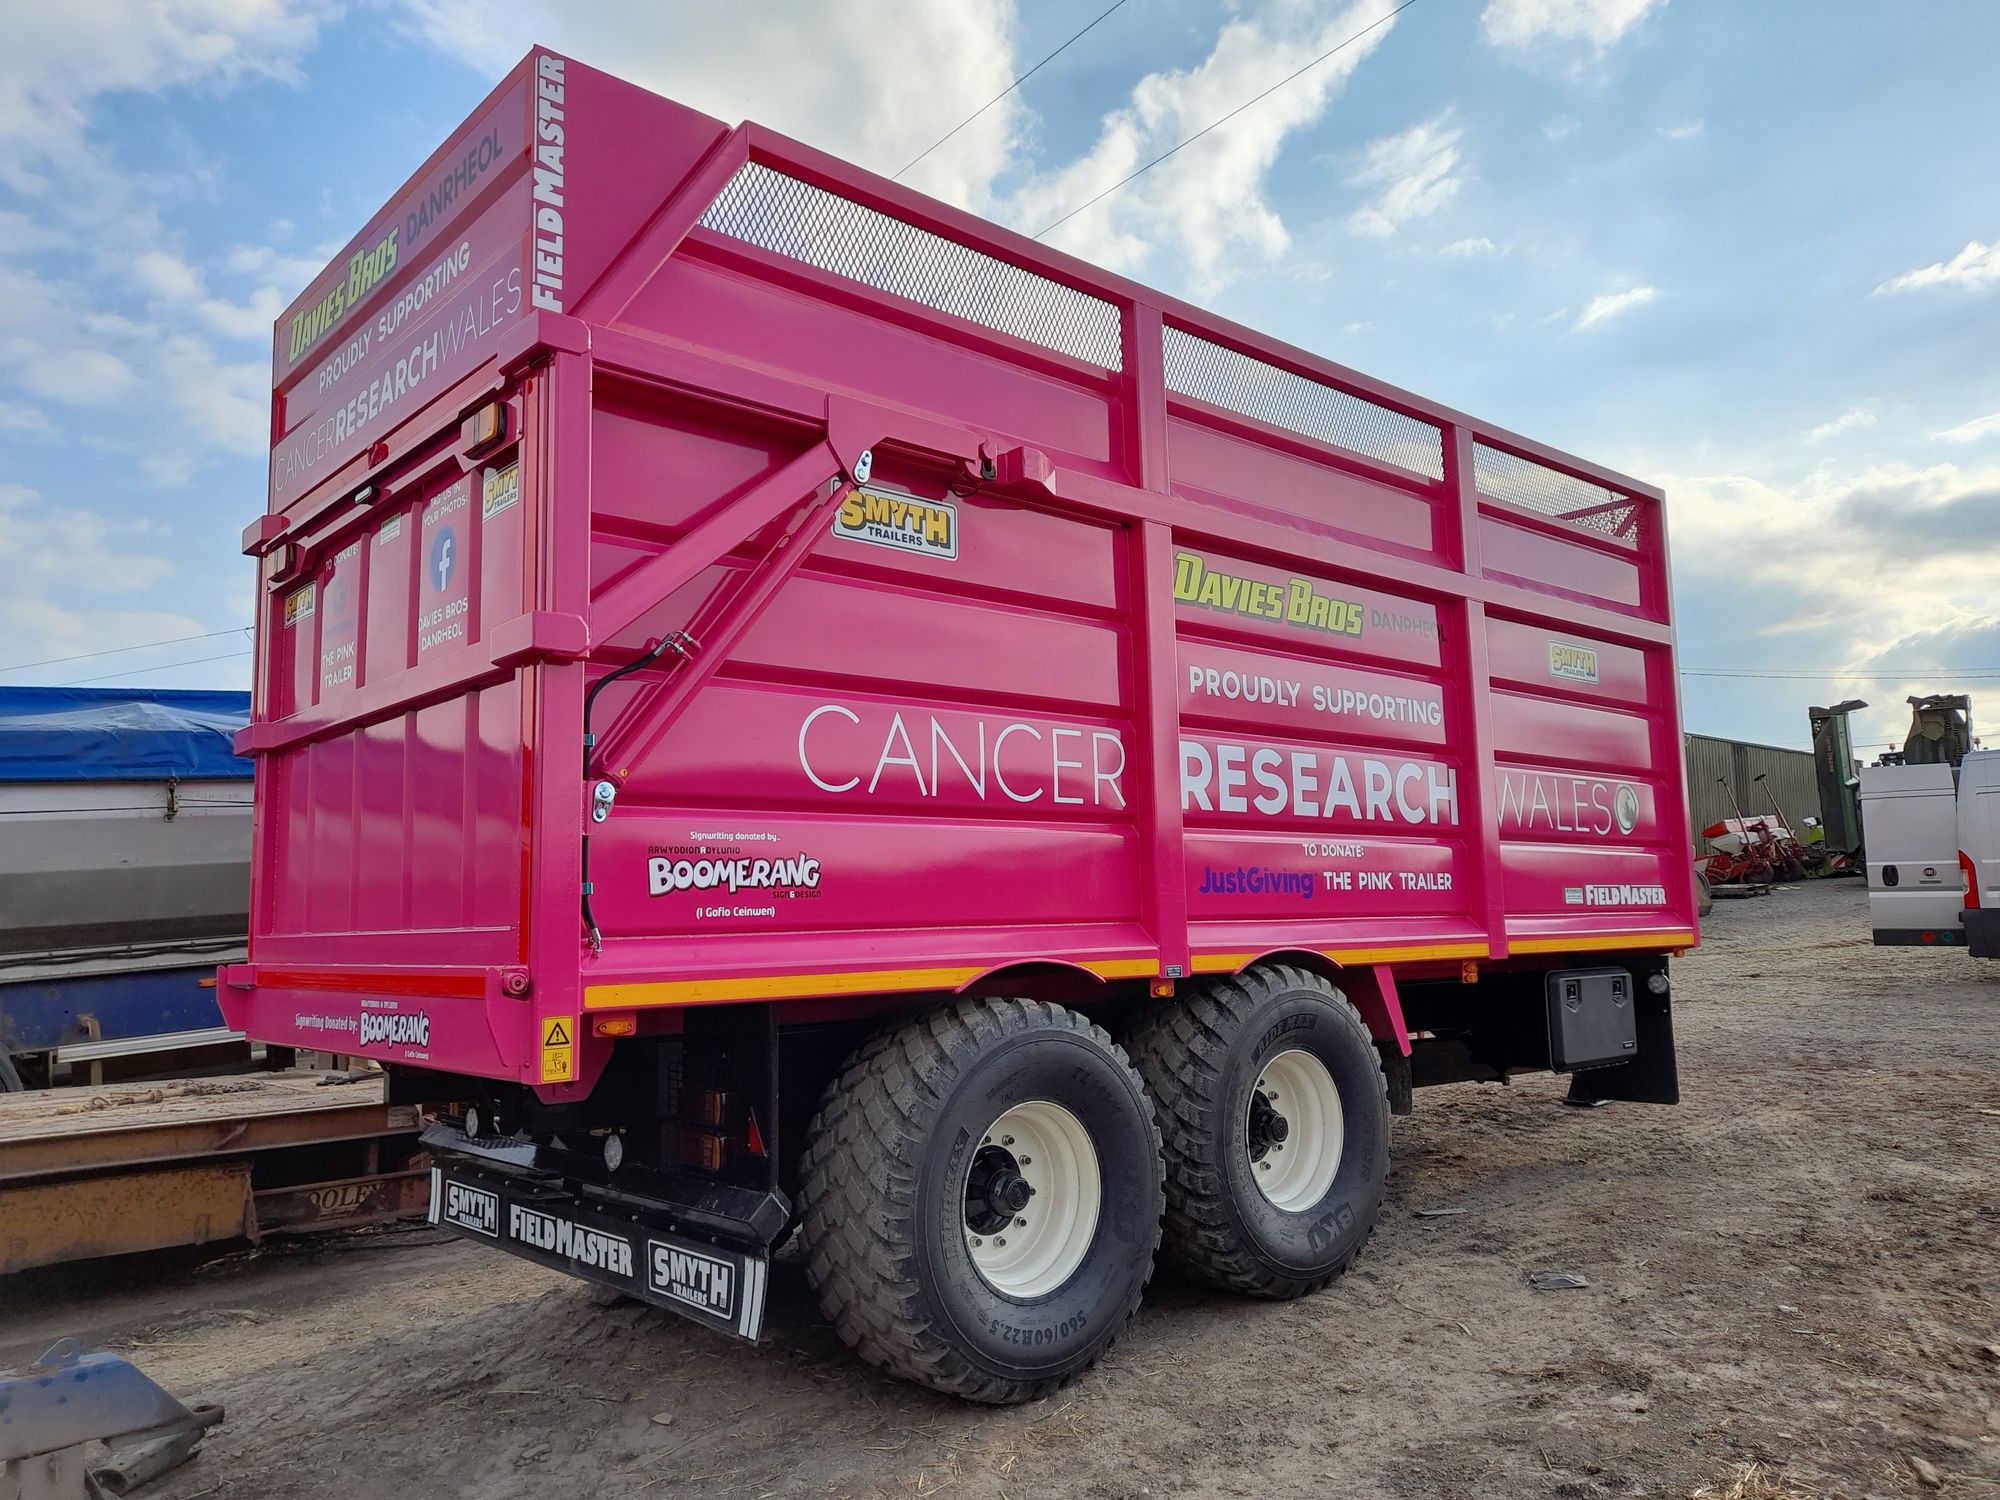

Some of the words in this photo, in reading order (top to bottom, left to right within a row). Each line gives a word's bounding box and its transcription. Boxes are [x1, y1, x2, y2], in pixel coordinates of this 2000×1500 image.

[532, 54, 565, 313] FIELDMASTER
[288, 280, 346, 365] DAVIES
[346, 226, 400, 309] BROS
[406, 126, 503, 247] DANRHEOL
[319, 327, 374, 394] PROUDLY
[378, 241, 471, 343] SUPPORTING
[443, 487, 452, 500] US
[453, 482, 461, 494] IN
[424, 510, 439, 528] YOUR
[840, 490, 952, 549] SMYTH
[868, 526, 923, 546] TRAILERS
[325, 558, 333, 572] TO
[1173, 551, 1285, 623] DAVIES
[1286, 576, 1364, 638] BROS
[418, 608, 443, 633] DAVIES
[445, 597, 469, 619] BROS
[421, 621, 463, 651] DANRHEOL
[322, 650, 335, 669] THE
[336, 641, 355, 663] PINK
[1552, 645, 1596, 677] SMYTH
[324, 665, 352, 689] TRAILER
[1188, 665, 1302, 707] PROUDLY
[1311, 684, 1442, 726] SUPPORTING
[798, 704, 1127, 808] CANCER
[1179, 740, 1460, 826] RESEARCH
[690, 831, 733, 841] Signwriting
[735, 832, 766, 840] donated
[1302, 842, 1317, 857] TO
[1321, 844, 1365, 858] DONATE:
[647, 851, 821, 896] BOOMERANG
[1199, 866, 1315, 899] JustGiving
[1323, 871, 1352, 891] THE
[1358, 872, 1393, 891] PINK
[1399, 872, 1453, 891] TRAILER
[1584, 884, 1667, 906] FIELDMASTER
[705, 906, 731, 918] Gofio
[733, 906, 776, 919] Ceinwen)
[295, 1013, 324, 1032] Signwriting
[324, 1015, 349, 1032] Donated
[359, 1008, 430, 1048] BOOMERANG
[448, 1184, 496, 1230] SMYTH
[458, 1211, 483, 1229] TRAILERS
[509, 1203, 635, 1278] FIELDMASTER
[1307, 1202, 1355, 1254] BKT
[653, 1247, 730, 1309] SMYTH
[671, 1282, 708, 1307] TRAILERS
[988, 1309, 1088, 1347] 560/60R22.5
